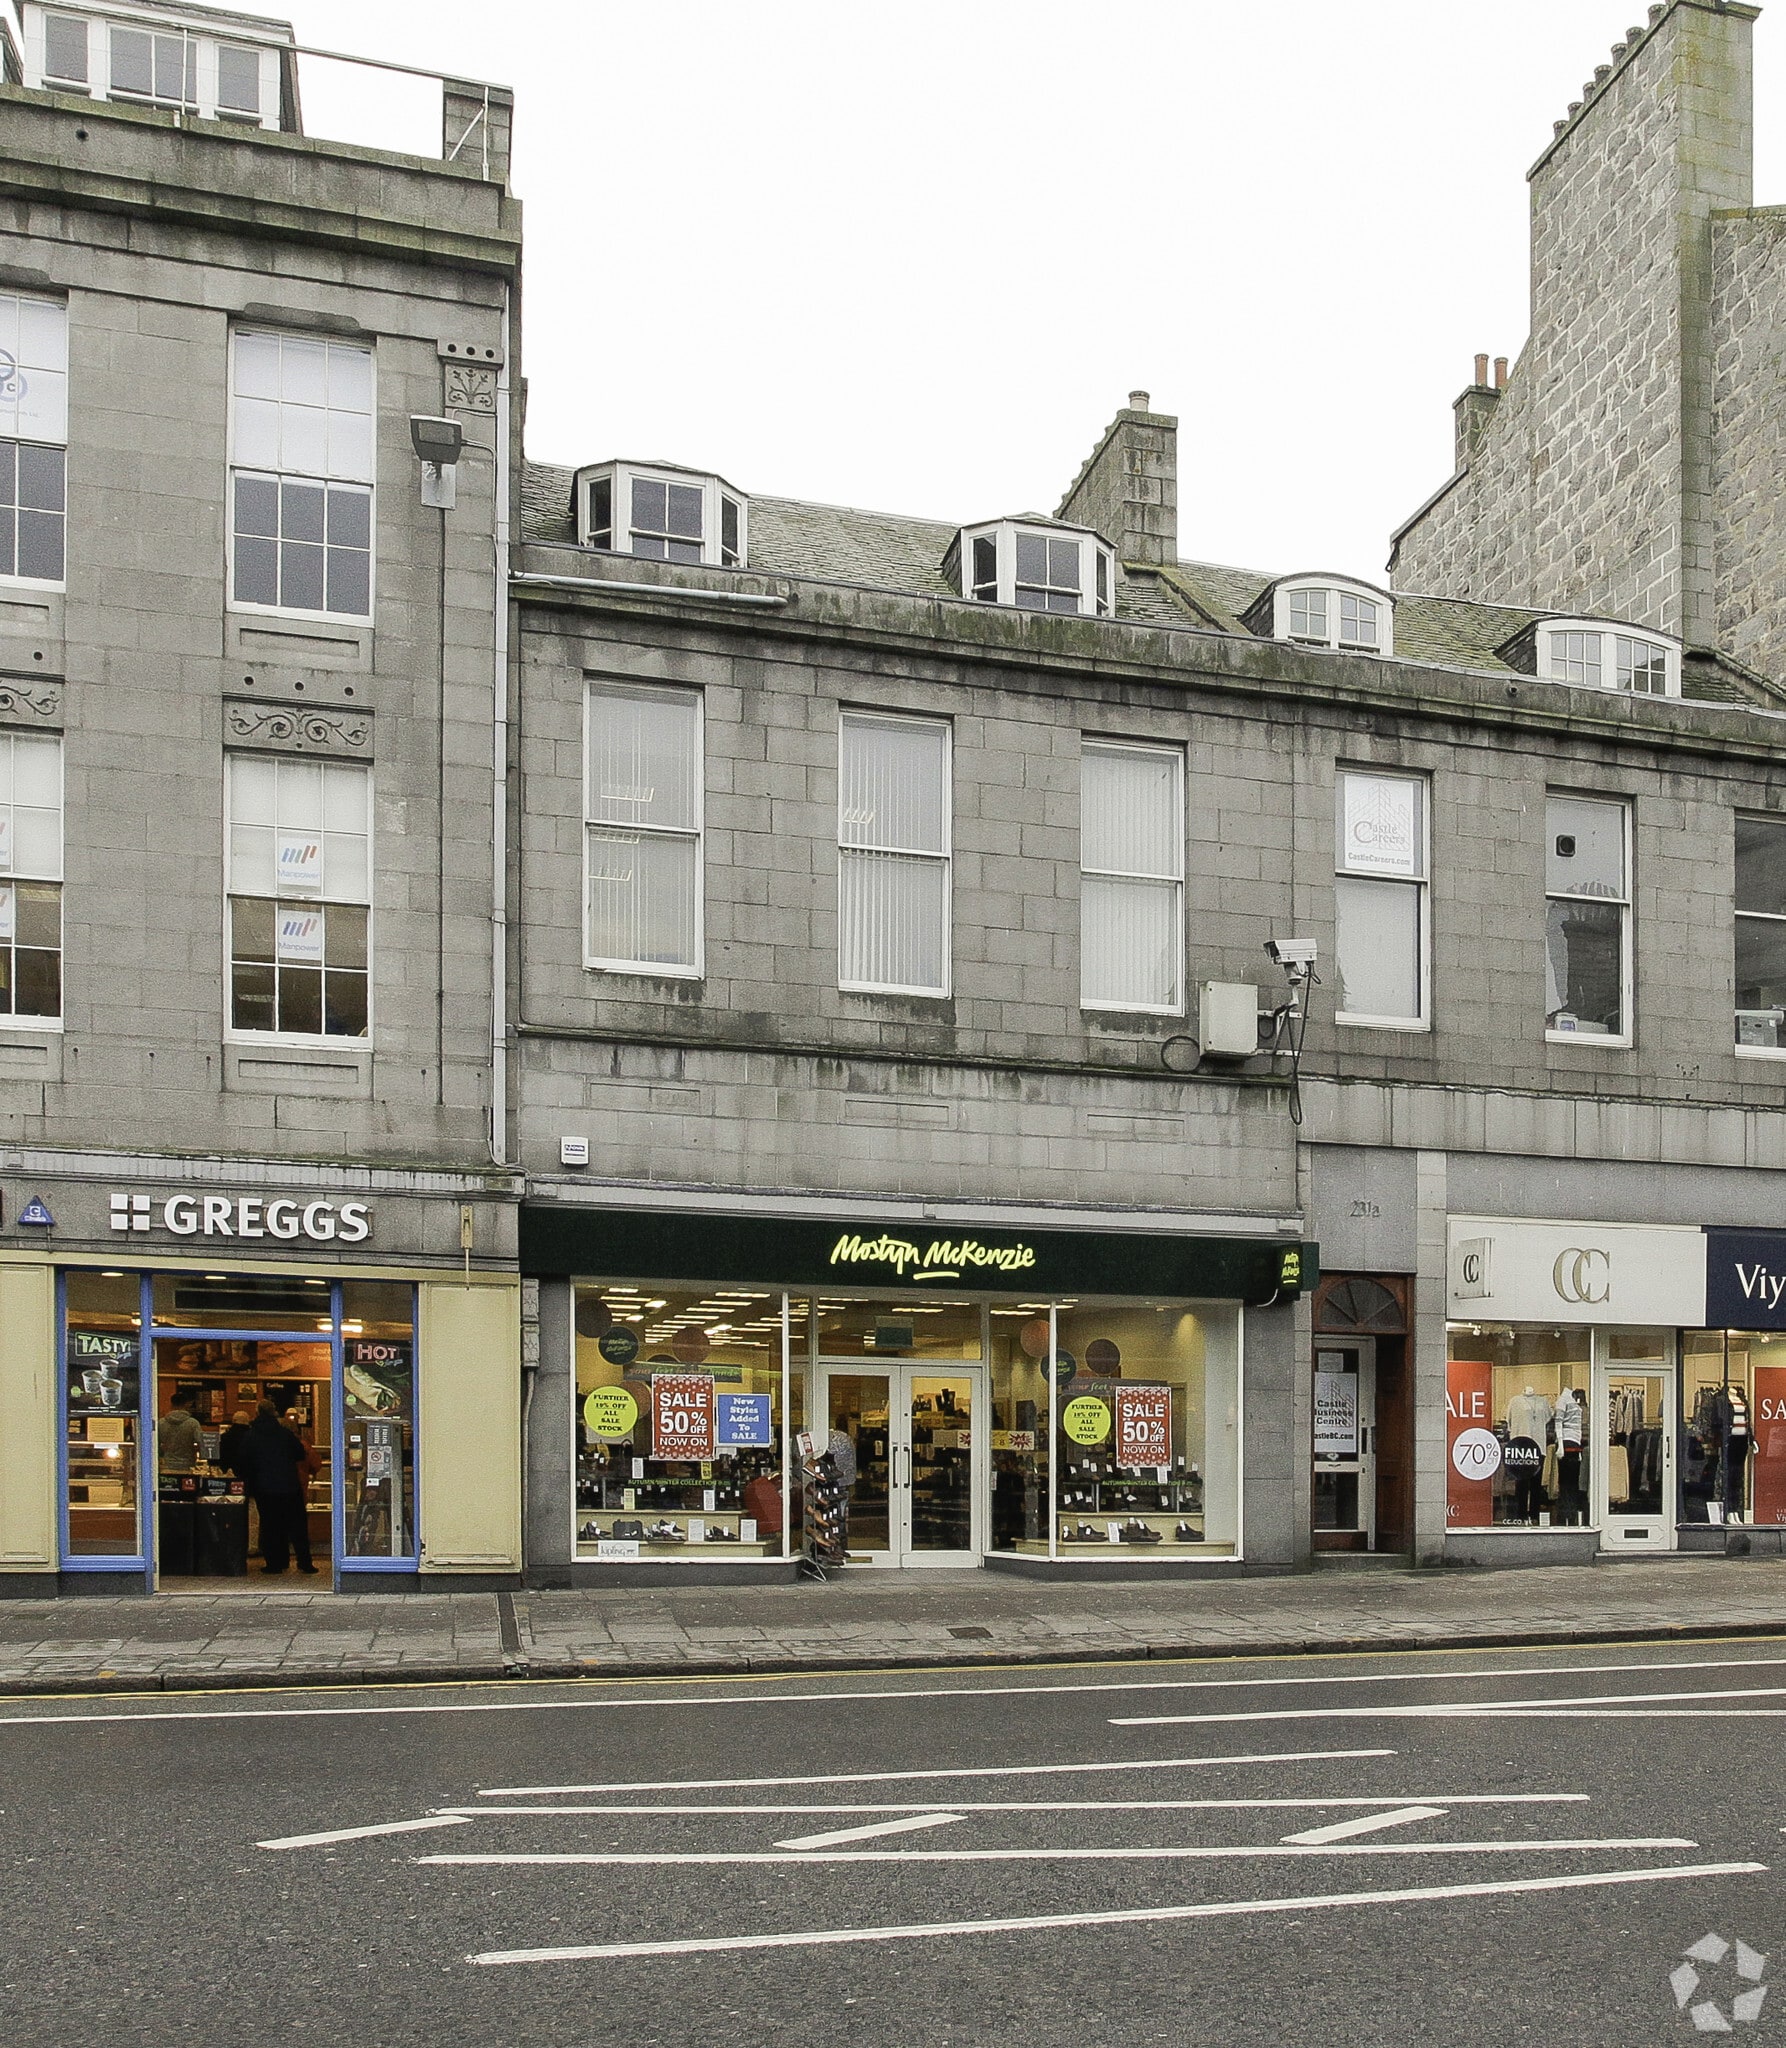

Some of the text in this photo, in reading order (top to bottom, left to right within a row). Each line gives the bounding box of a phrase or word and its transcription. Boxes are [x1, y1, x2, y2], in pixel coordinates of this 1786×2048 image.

[1354, 821, 1398, 843] Castle
[1348, 852, 1410, 866] CastleCareers.com
[278, 869, 320, 879] Manpower
[279, 943, 320, 952] Manpower
[164, 1194, 370, 1242] GREGGS
[830, 1234, 1036, 1275] Mostyn McKenzie
[1553, 1247, 1610, 1303] CC
[1735, 1263, 1786, 1310] Viy
[78, 1335, 128, 1353] TASTY
[357, 1344, 397, 1360] HOT
[660, 1392, 707, 1407] SALE
[1317, 1400, 1347, 1408] Castle
[1446, 1391, 1485, 1418] ALE
[730, 1406, 759, 1414] Styles
[1123, 1403, 1165, 1417] SALE
[660, 1411, 707, 1434] 50%
[1316, 1417, 1347, 1425] Centre
[690, 1425, 708, 1434] OFF
[1123, 1421, 1165, 1442] 50%
[1314, 1432, 1354, 1440] astleBC.com
[660, 1438, 708, 1446] NOW ON
[1123, 1446, 1165, 1454] NOW ON
[1460, 1443, 1499, 1465] 70%
[1505, 1447, 1540, 1459] FINAL
